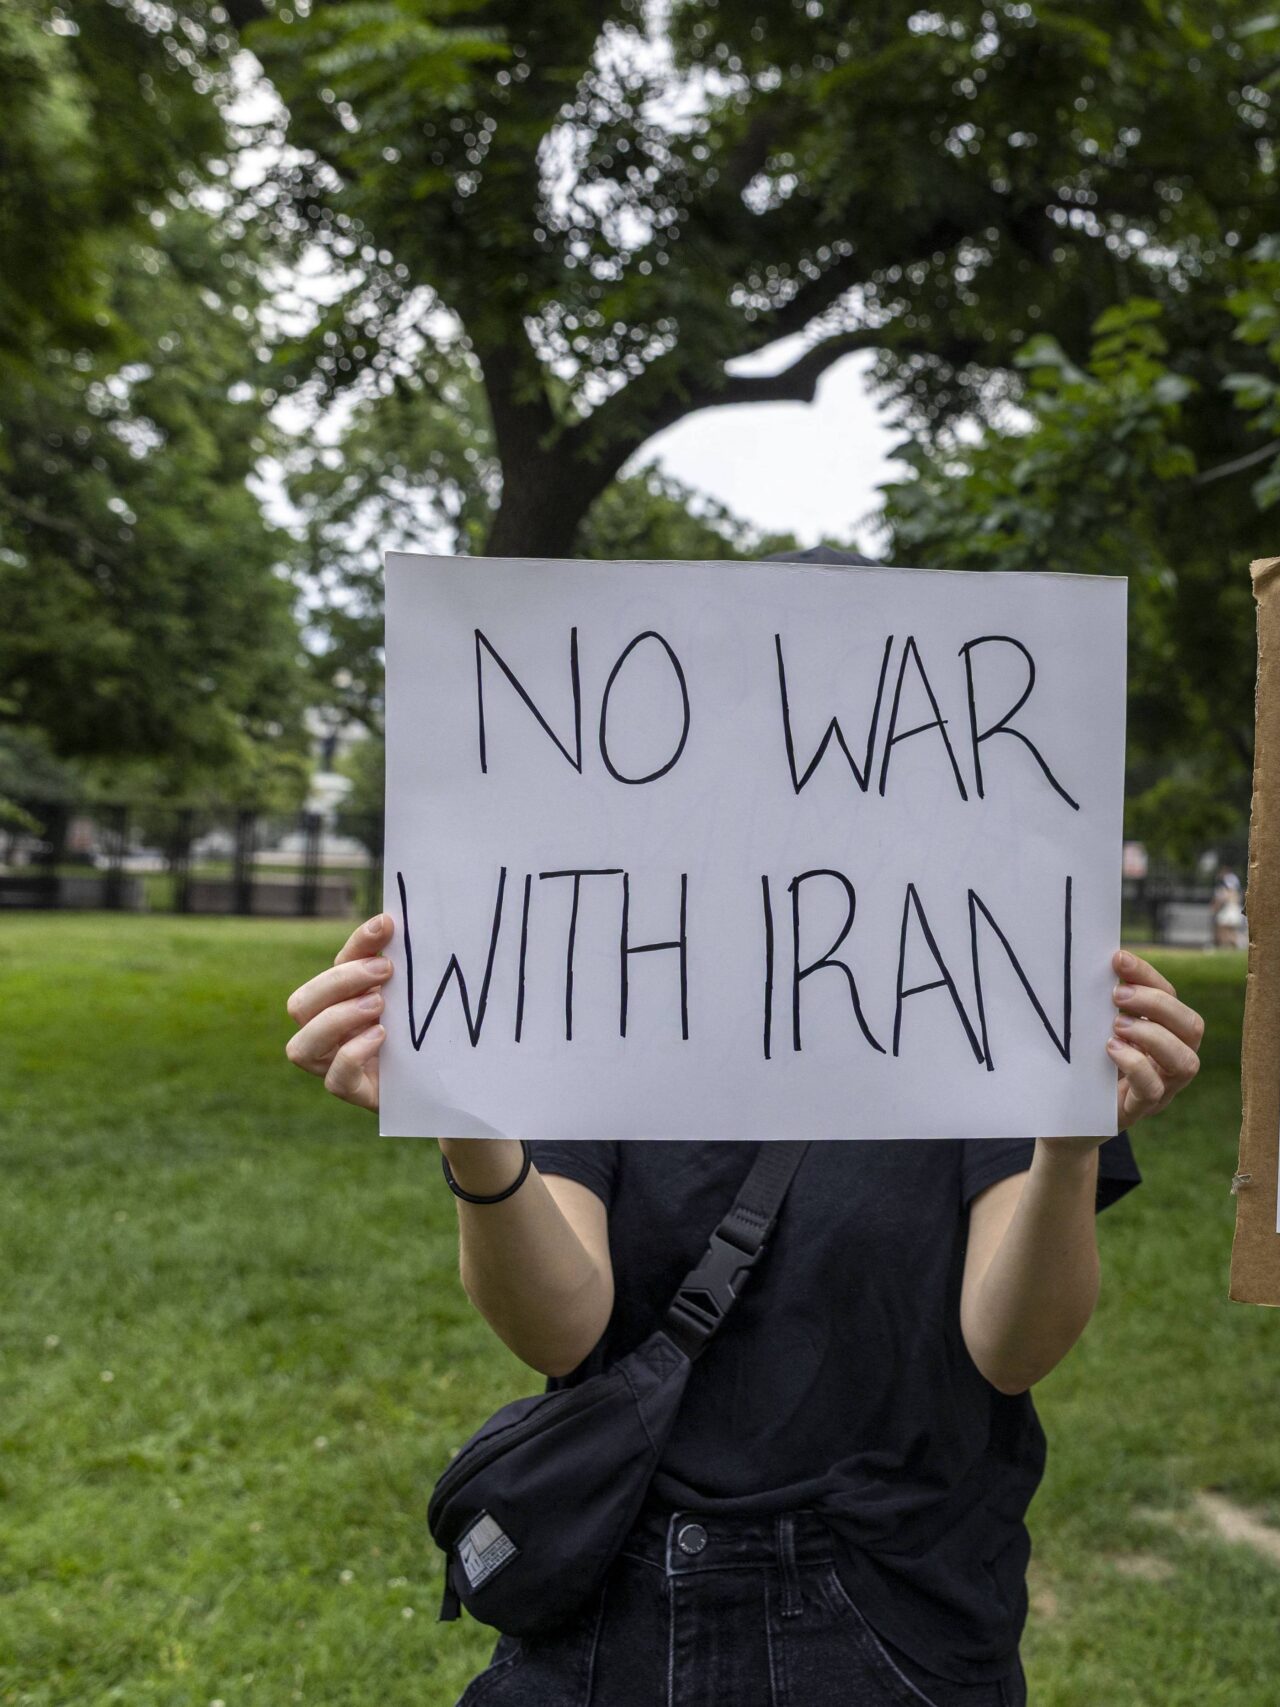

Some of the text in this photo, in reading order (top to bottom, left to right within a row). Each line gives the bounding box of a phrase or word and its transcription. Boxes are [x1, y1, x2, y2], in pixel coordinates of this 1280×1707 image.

[475, 627, 1080, 811] NO WAR
[397, 867, 1072, 1071] WITH IRAN
